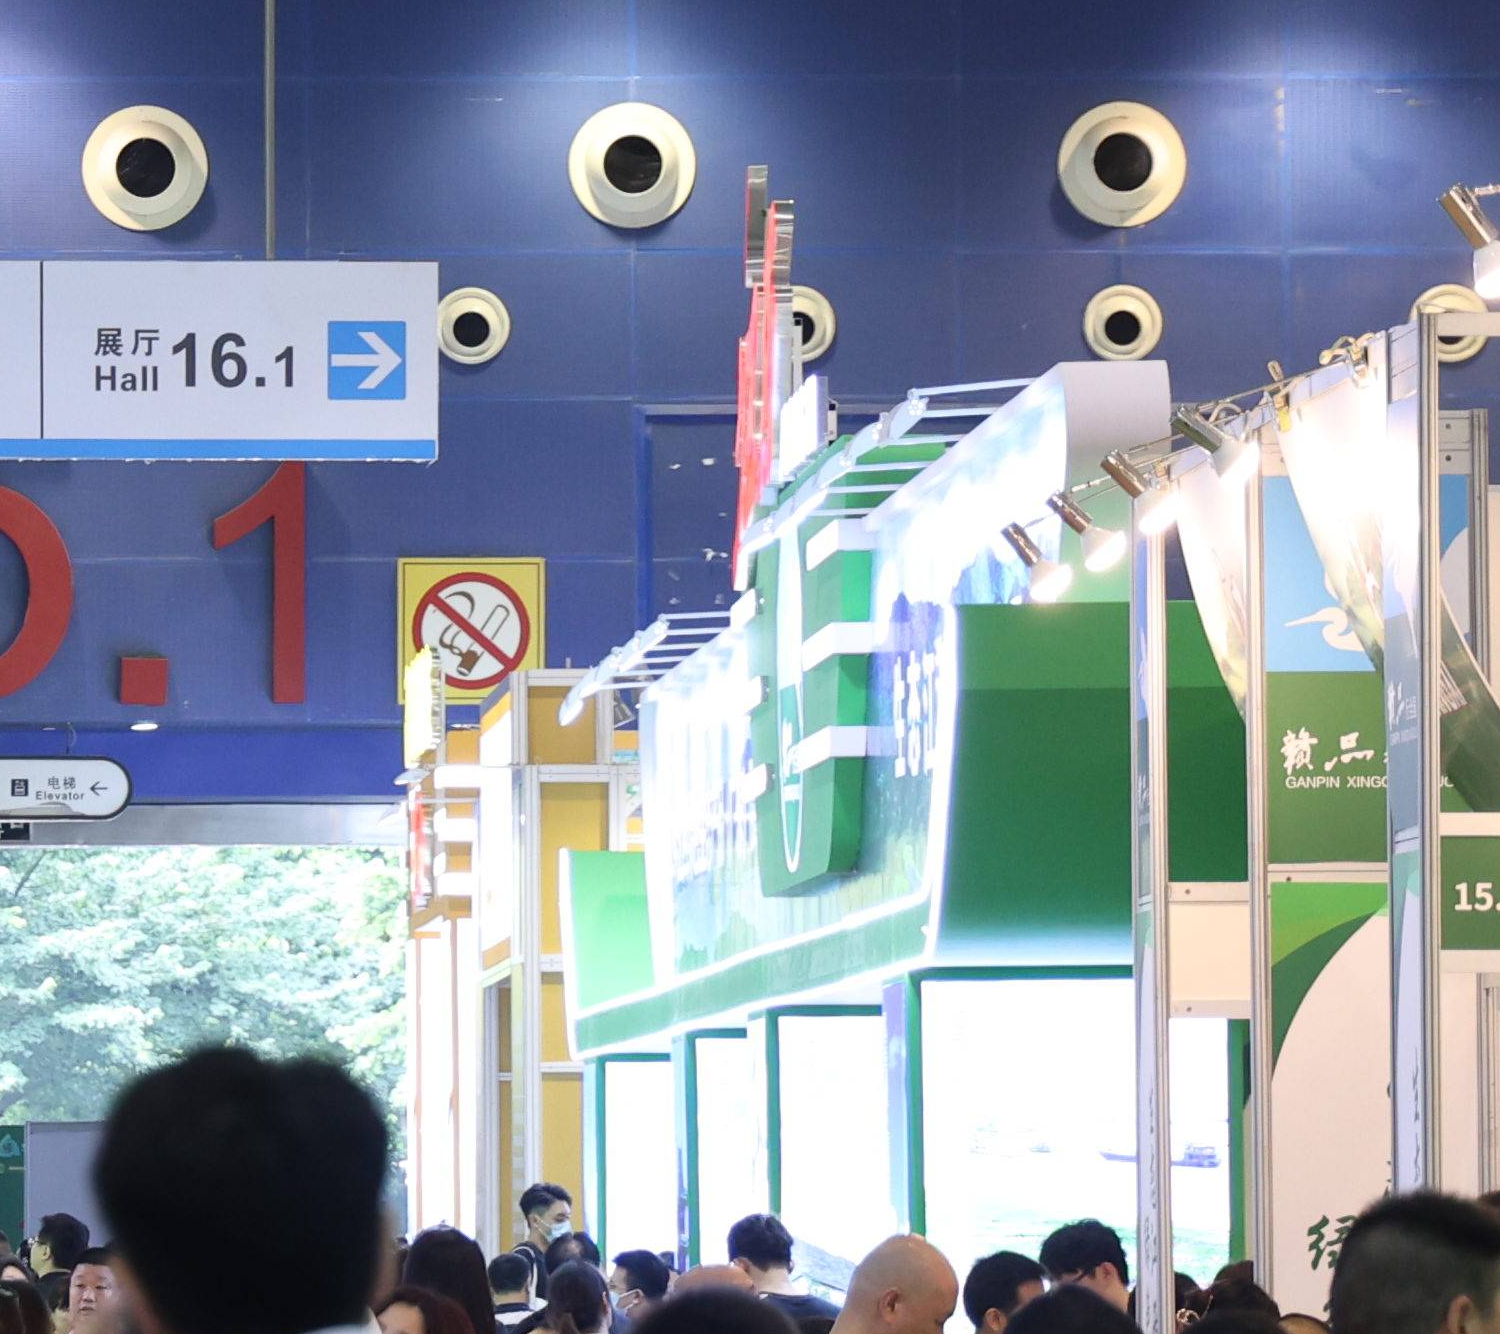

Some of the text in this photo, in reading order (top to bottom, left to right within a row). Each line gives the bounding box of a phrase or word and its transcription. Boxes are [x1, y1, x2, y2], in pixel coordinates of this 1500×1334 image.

[94, 327, 160, 357] 展厅
[94, 332, 295, 392] Hall 16.1
[47, 776, 77, 790] 电梯
[1285, 776, 1340, 789] GANPIN
[35, 791, 85, 802] Elevator
